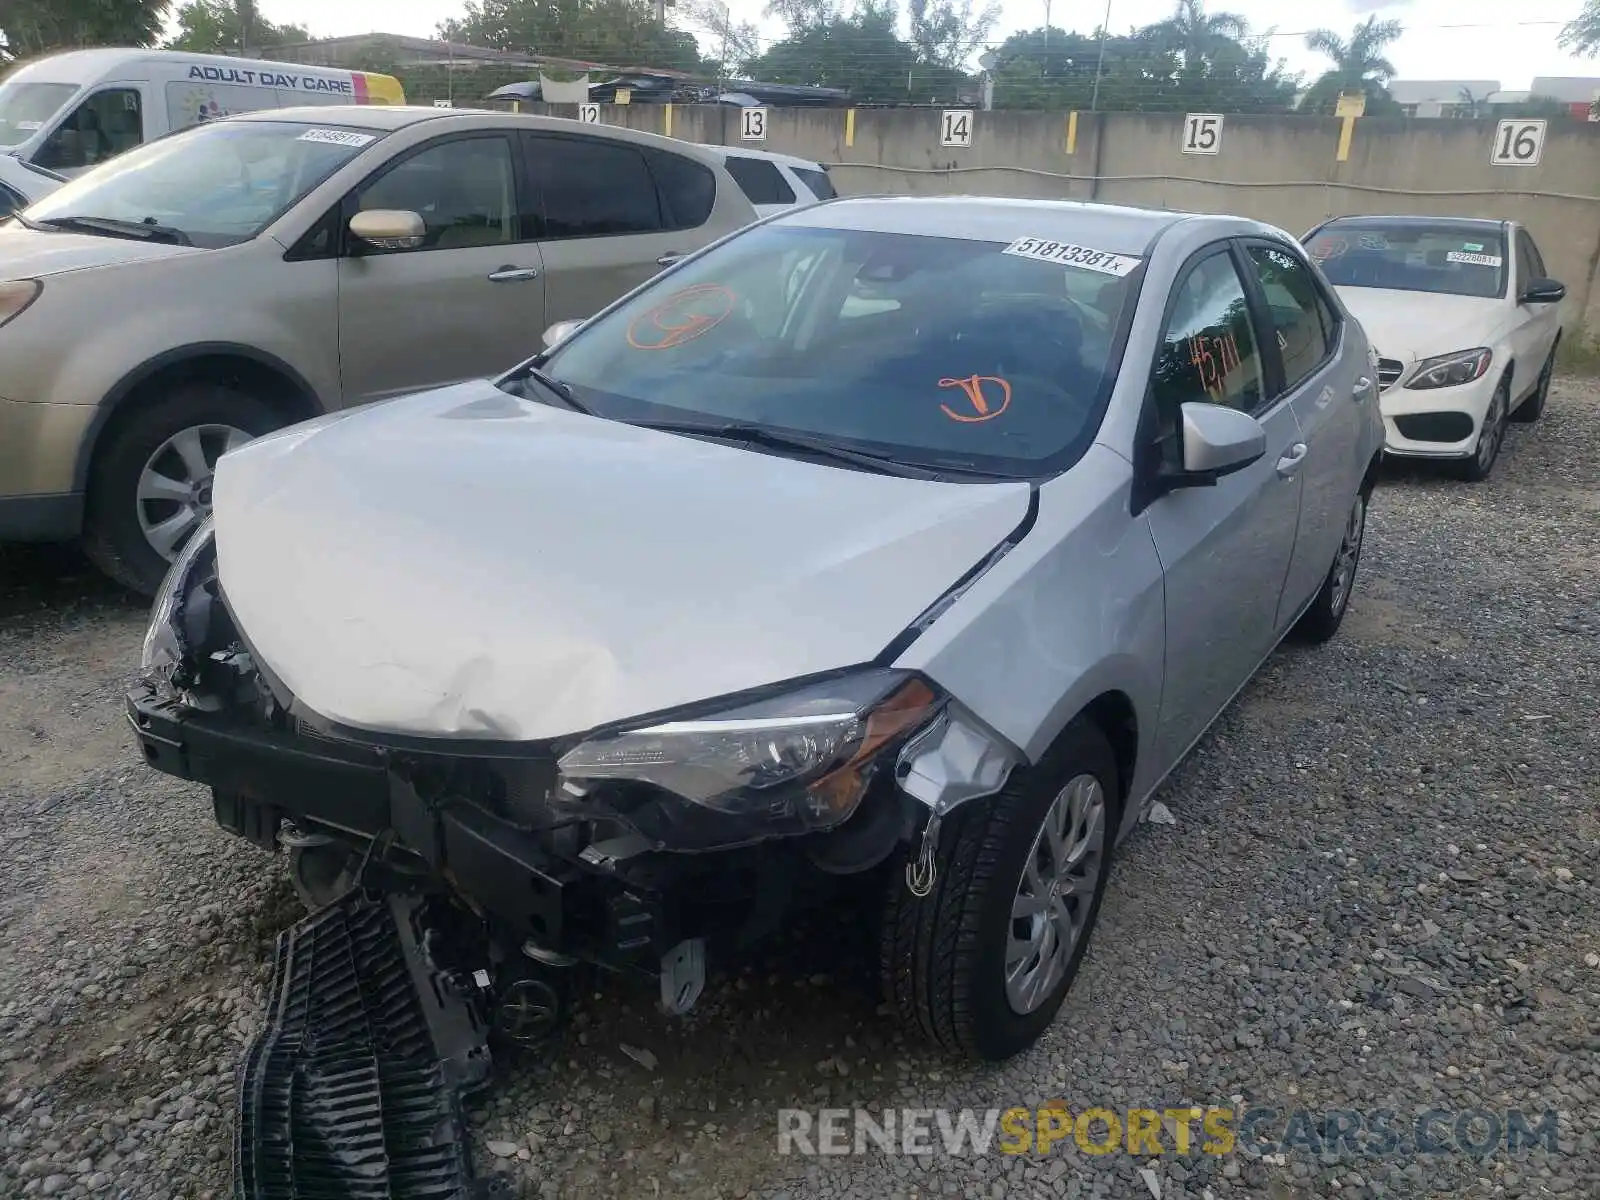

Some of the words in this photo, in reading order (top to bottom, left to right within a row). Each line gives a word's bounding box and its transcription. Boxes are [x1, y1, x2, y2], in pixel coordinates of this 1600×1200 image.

[188, 66, 255, 84] ADULT
[261, 73, 298, 89] DAY
[303, 77, 352, 93] CARE
[581, 106, 598, 122] 12
[744, 111, 764, 136] 13
[944, 115, 969, 142] 14
[1187, 119, 1217, 149] 15
[1498, 125, 1538, 159] 16
